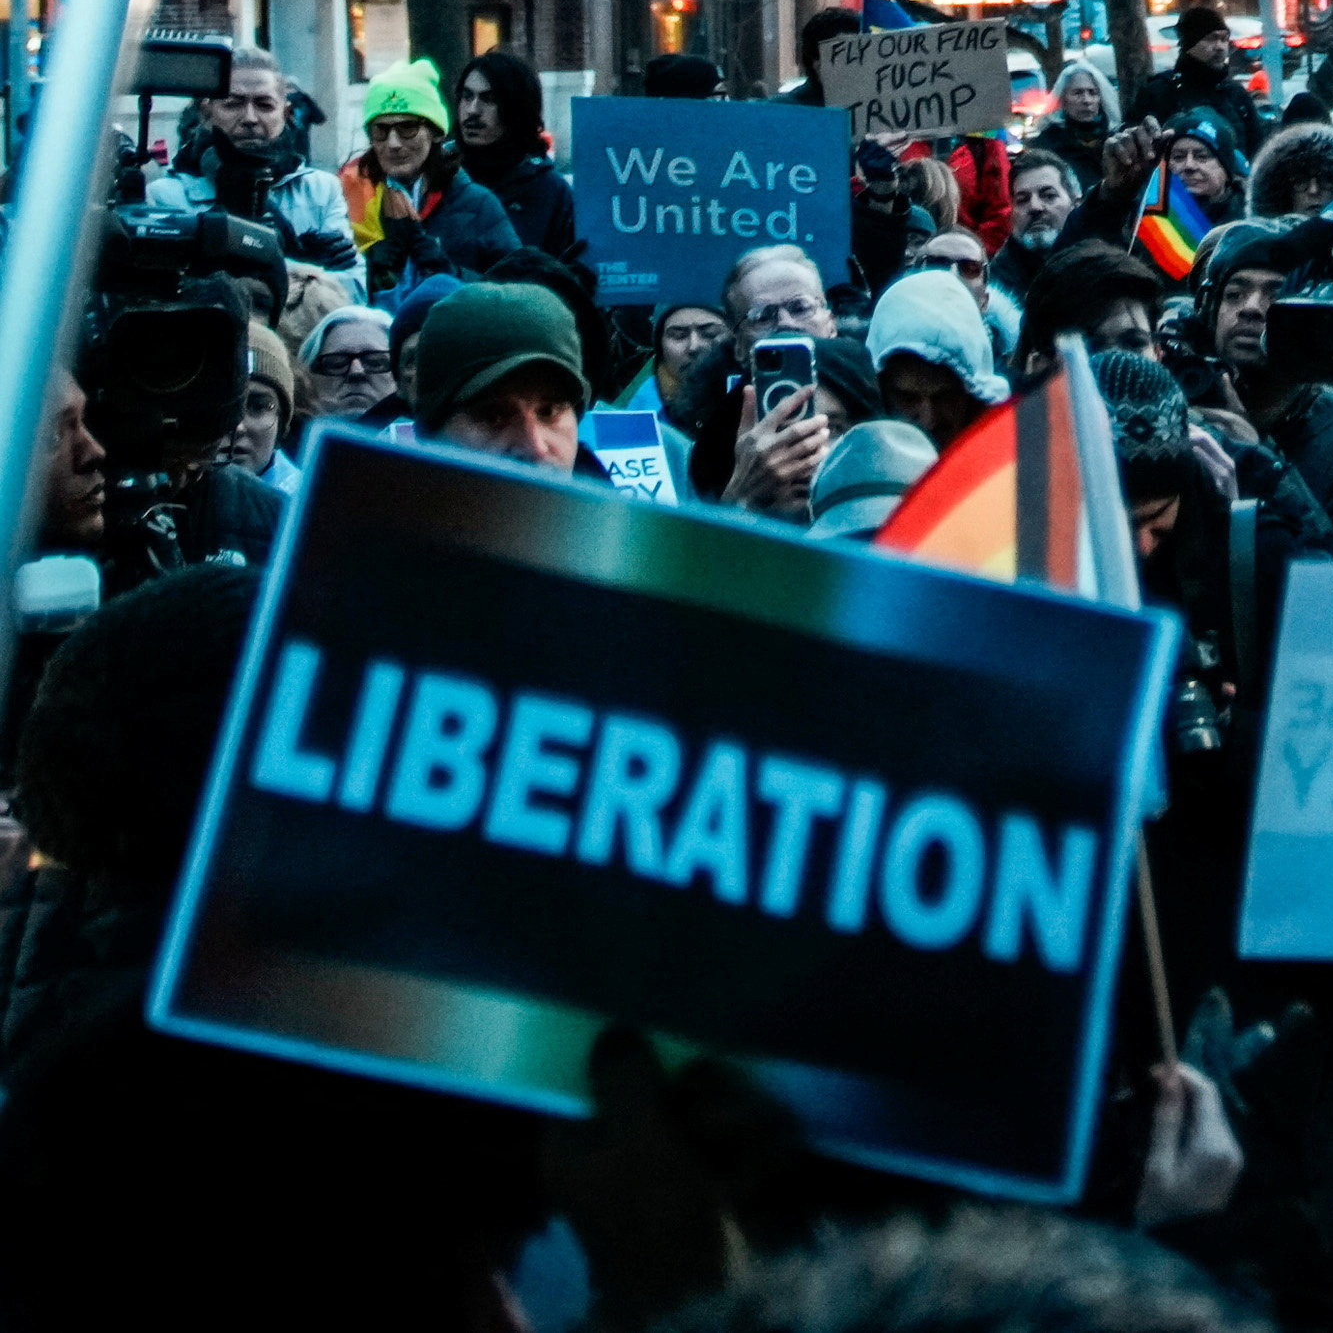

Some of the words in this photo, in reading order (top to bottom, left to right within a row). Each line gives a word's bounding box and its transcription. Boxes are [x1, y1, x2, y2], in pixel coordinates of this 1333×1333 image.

[830, 37, 872, 66] FLY
[878, 34, 933, 59] OUR
[937, 25, 1000, 55] FLAG
[875, 58, 956, 95] FUCK
[847, 83, 977, 136] TRUMP
[605, 146, 697, 187] We
[719, 150, 819, 195] Are
[611, 194, 816, 243] United.
[248, 637, 1099, 975] LIBERATION
